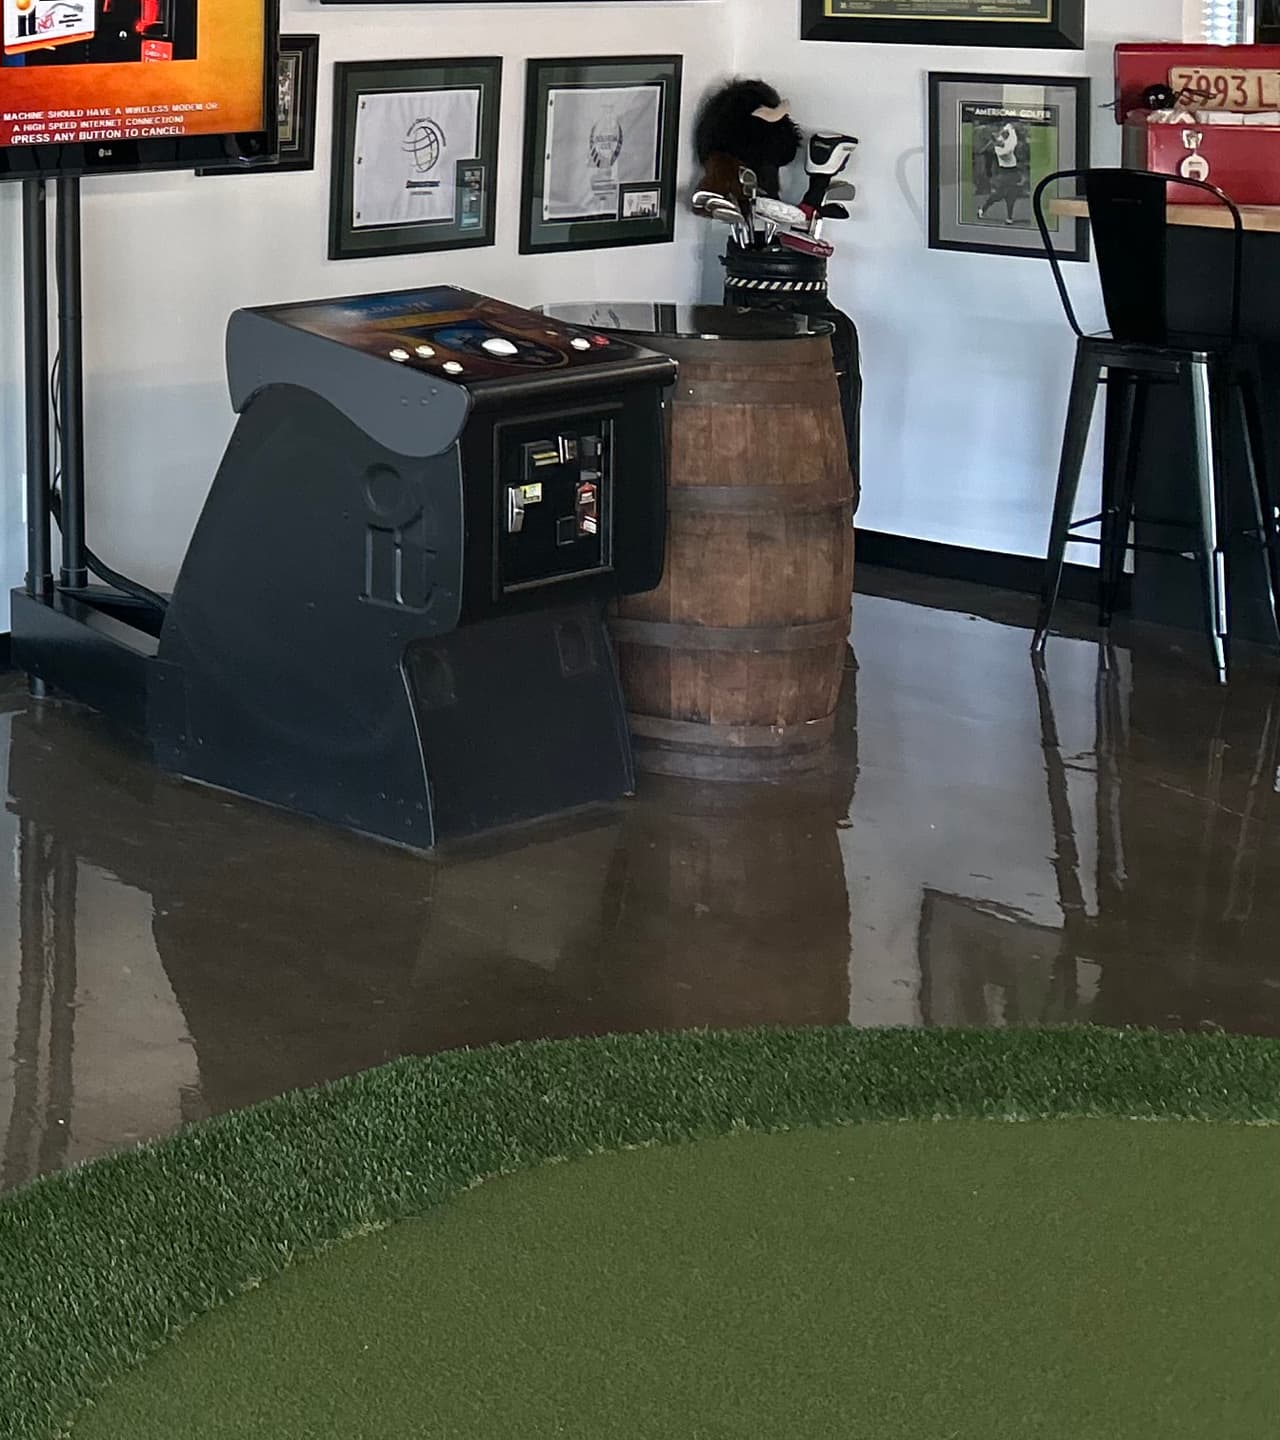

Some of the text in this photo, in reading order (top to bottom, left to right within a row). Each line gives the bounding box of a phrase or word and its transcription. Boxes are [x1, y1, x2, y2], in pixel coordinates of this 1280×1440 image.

[3, 110, 44, 122] MACHINE
[47, 109, 85, 119] SHOULD
[86, 107, 111, 117] HAVE
[114, 106, 123, 116] A
[125, 104, 169, 115] WIRELESS
[172, 103, 203, 113] MODEM
[10, 125, 185, 145] (PRESS ANY BUTTON TO CANCEL)
[13, 125, 20, 133] A
[23, 123, 46, 133] HIGH
[48, 121, 77, 131] SPEED
[80, 119, 122, 130] INTERNET
